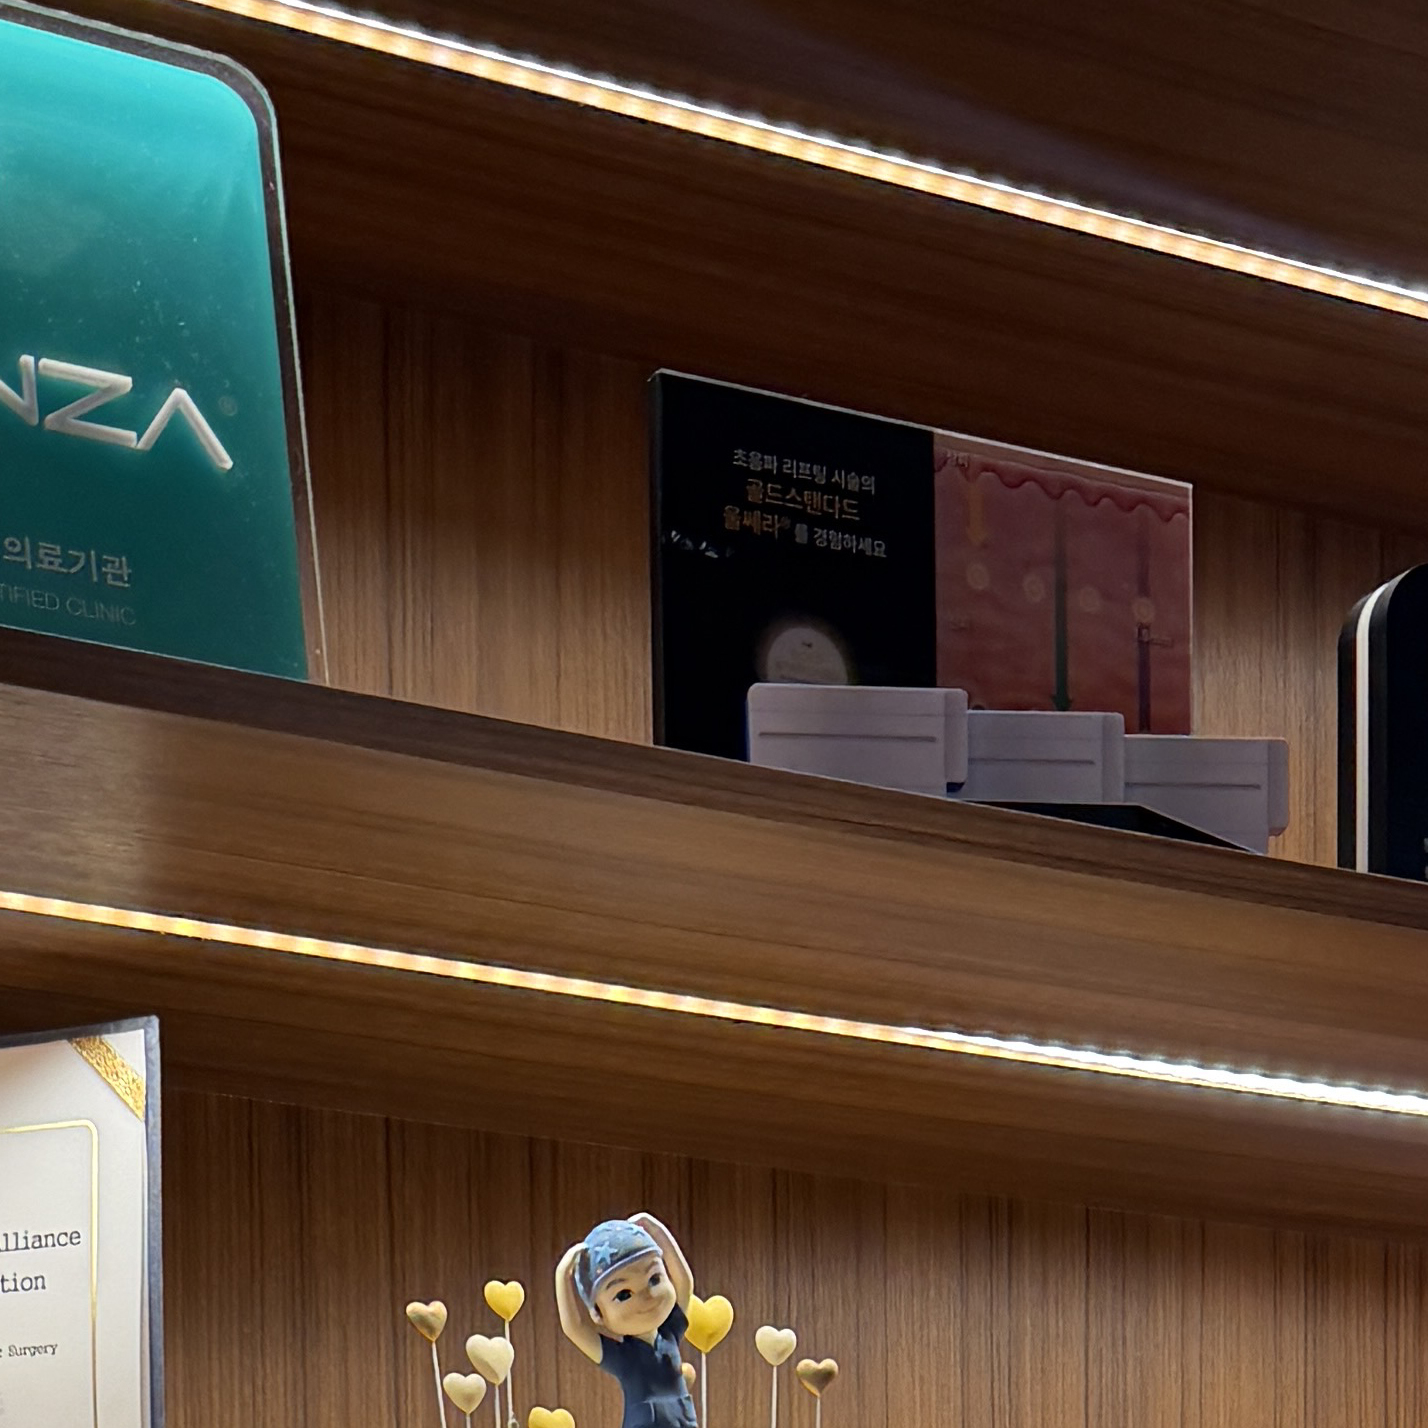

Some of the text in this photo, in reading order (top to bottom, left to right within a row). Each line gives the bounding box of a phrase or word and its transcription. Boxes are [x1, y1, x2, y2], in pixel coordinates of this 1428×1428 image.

[782, 459, 826, 485] 리프팅
[831, 470, 875, 496] 시술의
[746, 478, 860, 521] 골드스탠다드
[813, 527, 887, 558] 경험하세요
[3, 535, 132, 589] 의료기관
[65, 596, 138, 627] CLINIC
[7, 1342, 59, 1358] Surgery
